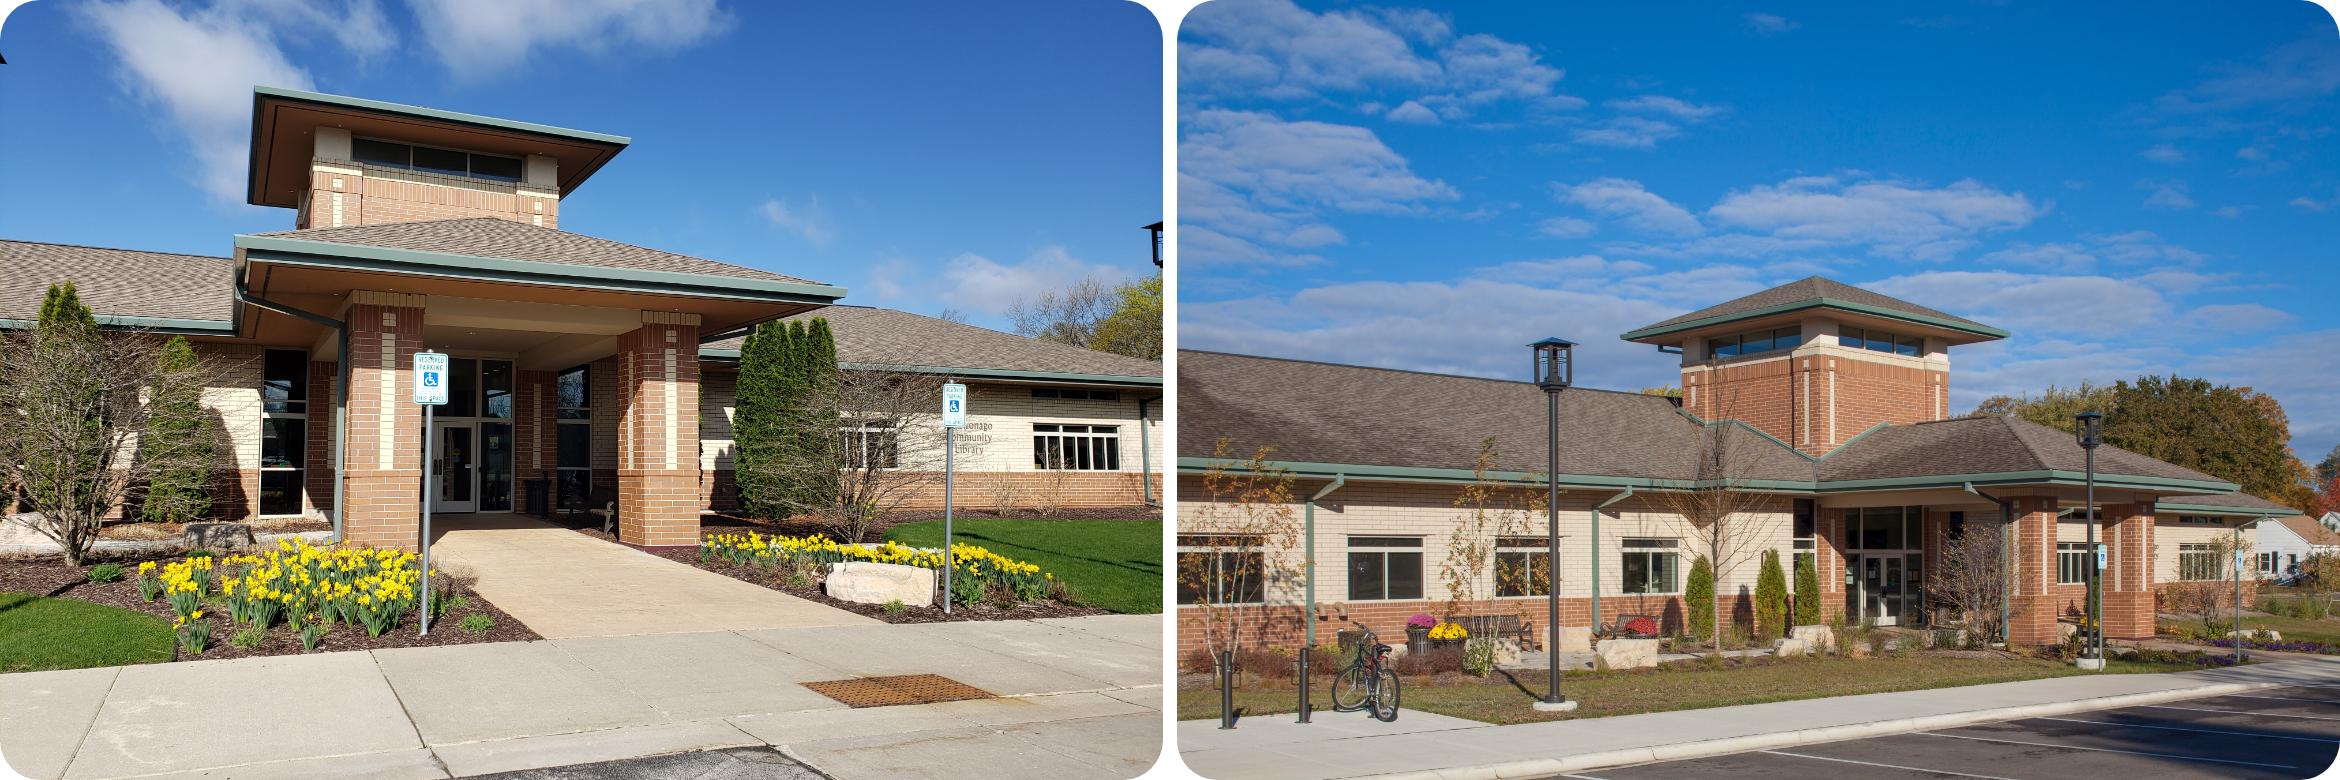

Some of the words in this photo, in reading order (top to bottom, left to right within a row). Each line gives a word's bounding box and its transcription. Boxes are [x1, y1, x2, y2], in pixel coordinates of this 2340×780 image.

[418, 356, 445, 364] RESERVED
[952, 432, 993, 443] ommunity
[955, 444, 984, 455] Library
